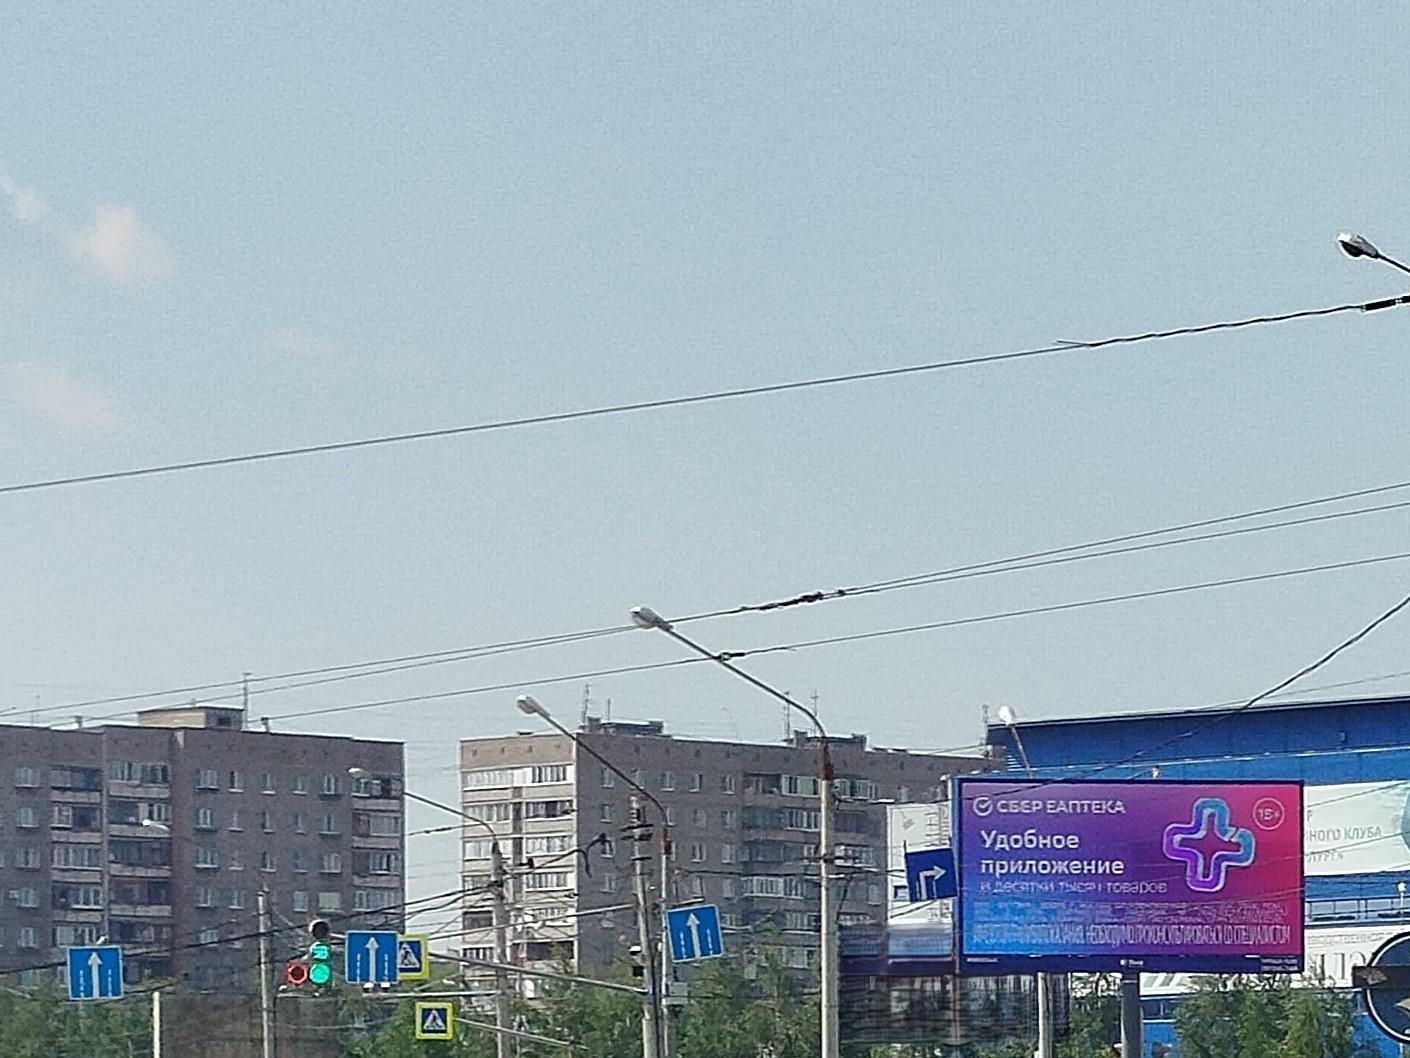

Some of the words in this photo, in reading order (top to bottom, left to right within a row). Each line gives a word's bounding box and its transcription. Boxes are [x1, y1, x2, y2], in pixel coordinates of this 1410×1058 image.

[997, 800, 1043, 813] СБЕР
[1046, 800, 1126, 814] ЕАПТЕКА
[980, 829, 1080, 851] Удобное
[1344, 826, 1382, 840] КЛУБА
[980, 859, 1125, 878] приложение
[1107, 881, 1167, 894] товаров
